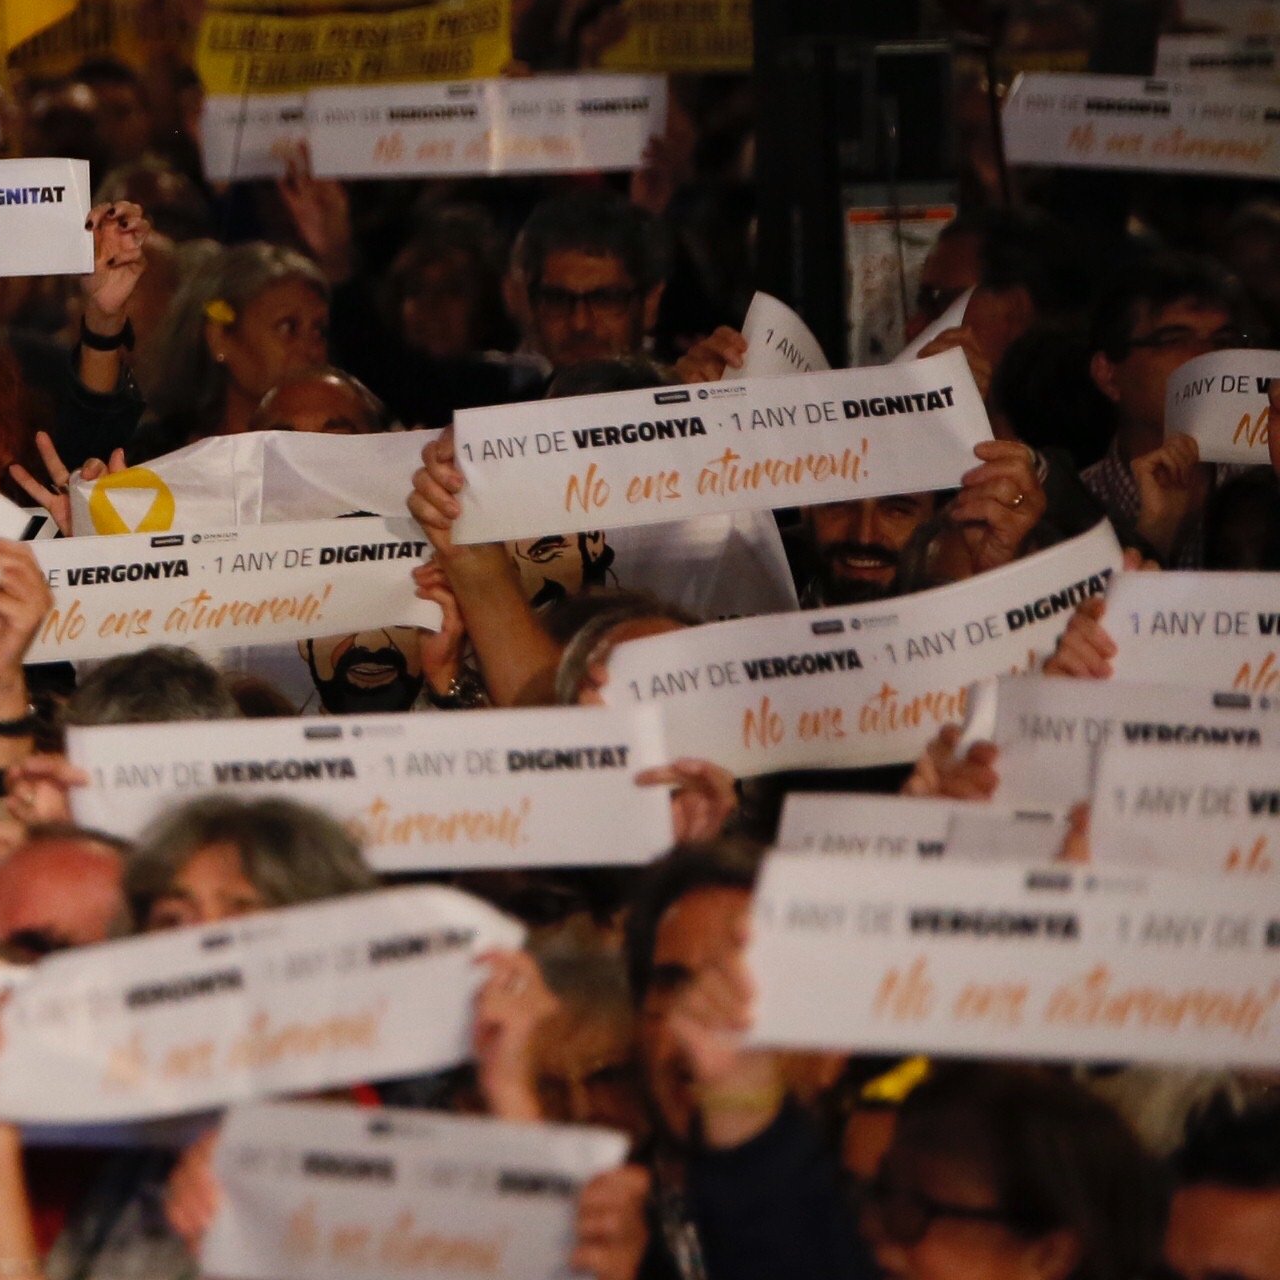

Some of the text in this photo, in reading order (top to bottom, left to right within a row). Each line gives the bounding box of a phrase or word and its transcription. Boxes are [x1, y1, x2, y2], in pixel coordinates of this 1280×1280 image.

[776, 337, 806, 369] ANY
[462, 387, 953, 462] 1 ANY DE VERGONYA 1 ANY DE DIGNITAT
[564, 464, 608, 512] No
[625, 471, 681, 502] ens
[47, 536, 431, 589] E VERGONYA 1 ANY DE DIGNITAT
[35, 597, 83, 641] No
[98, 610, 153, 636] ens
[629, 680, 642, 701] 1
[651, 668, 700, 698] ANY
[707, 661, 741, 688] DE
[743, 649, 863, 681] VERGONYA
[883, 642, 897, 664] 1
[905, 629, 955, 662] ANY
[965, 616, 1002, 646] DE
[214, 746, 628, 786] VERGONYA DIGNITAT
